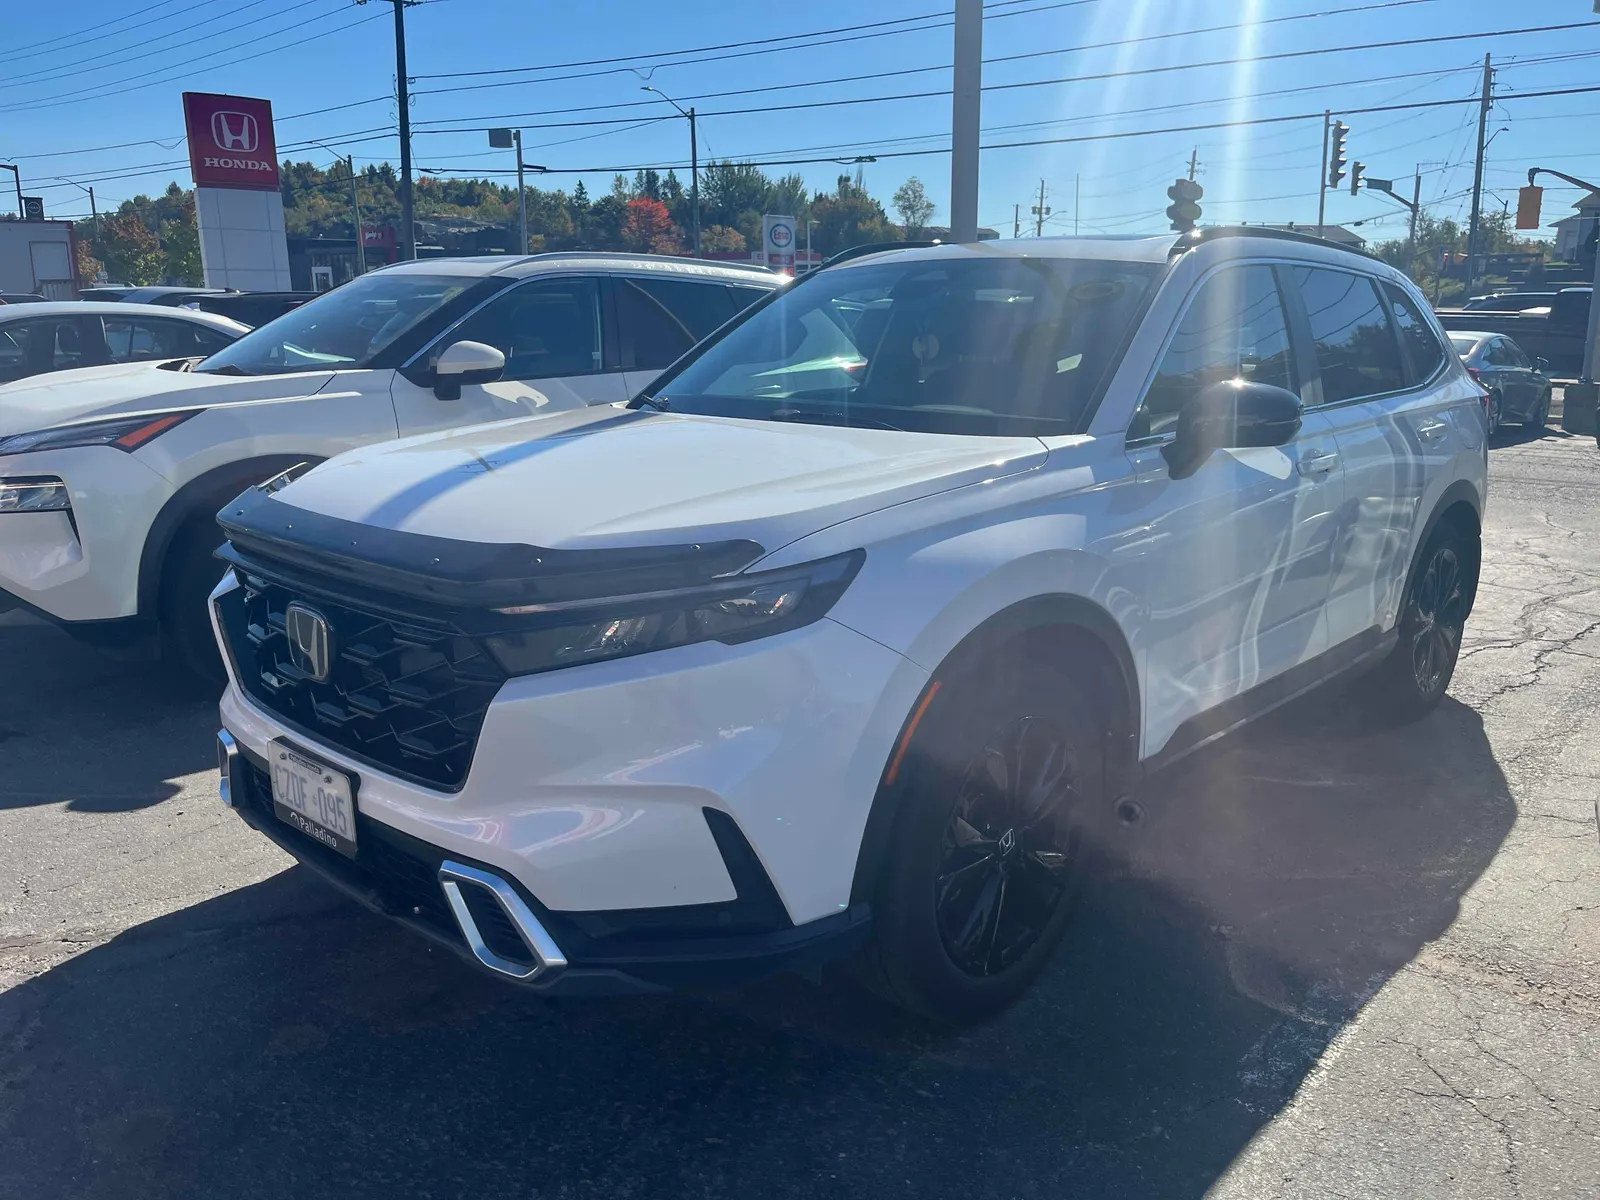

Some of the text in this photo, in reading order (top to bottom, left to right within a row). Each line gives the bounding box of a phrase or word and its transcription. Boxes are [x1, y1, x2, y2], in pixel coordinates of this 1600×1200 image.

[204, 157, 272, 171] HONDA
[275, 764, 347, 835] CZDF 095
[299, 817, 337, 847] Palladino
